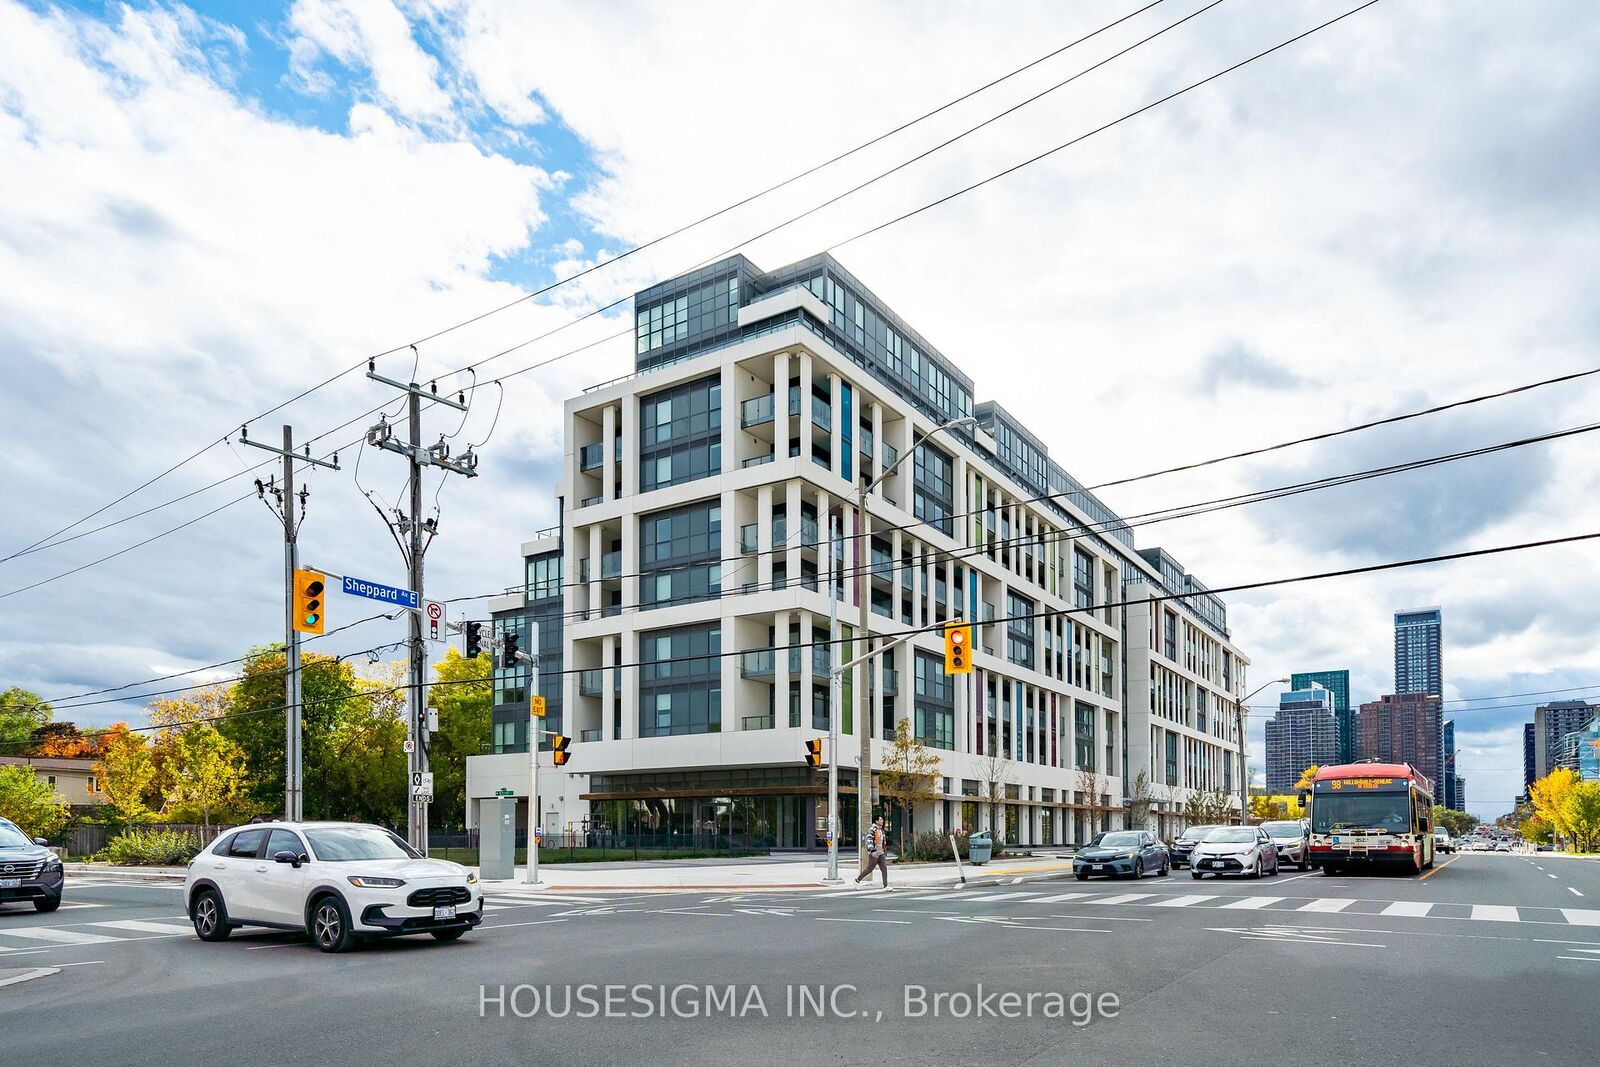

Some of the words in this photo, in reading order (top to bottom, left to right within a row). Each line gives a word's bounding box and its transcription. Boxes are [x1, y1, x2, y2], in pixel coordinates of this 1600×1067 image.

[345, 578, 397, 600] Sheppard
[410, 593, 416, 604] E
[1331, 780, 1341, 789] 98
